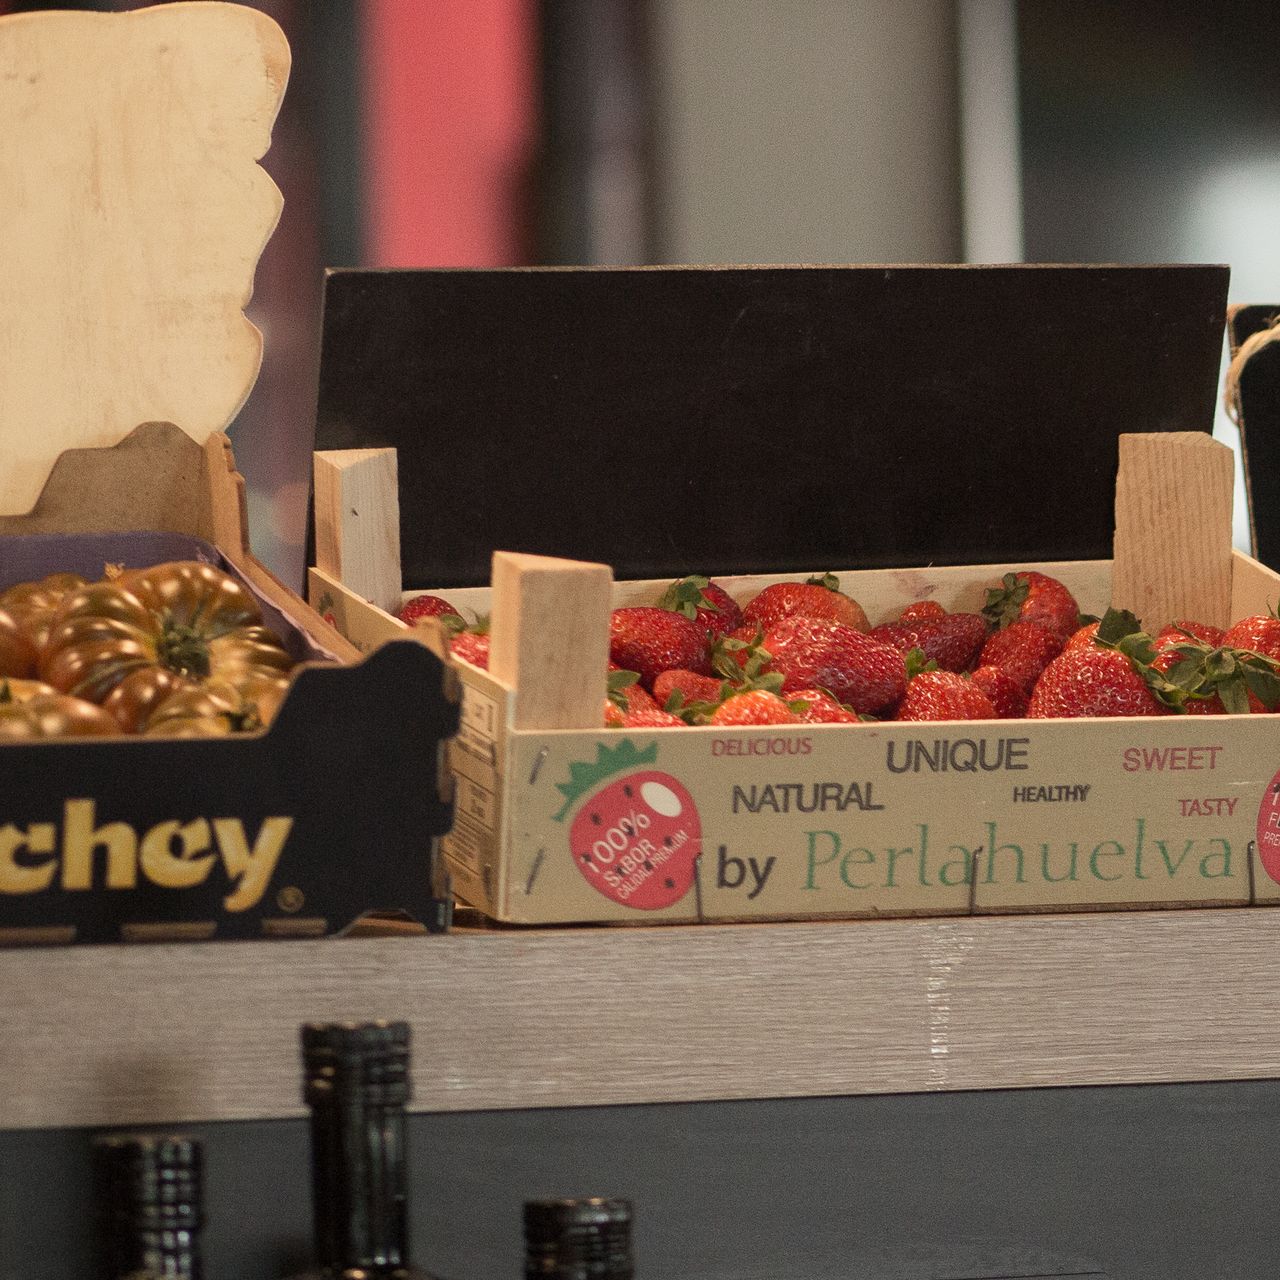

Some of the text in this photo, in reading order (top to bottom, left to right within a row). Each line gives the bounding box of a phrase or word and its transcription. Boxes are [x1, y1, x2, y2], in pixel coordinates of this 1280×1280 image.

[712, 737, 813, 758] DELICIOUS
[886, 737, 1031, 774] UNIQUE
[1123, 746, 1223, 772] SWEET
[732, 782, 884, 814] NATURAL
[1013, 784, 1091, 803] HEALTHY
[1178, 798, 1238, 817] TASTY
[580, 809, 652, 874] 100%
[717, 818, 1235, 899] by Perlahuelva
